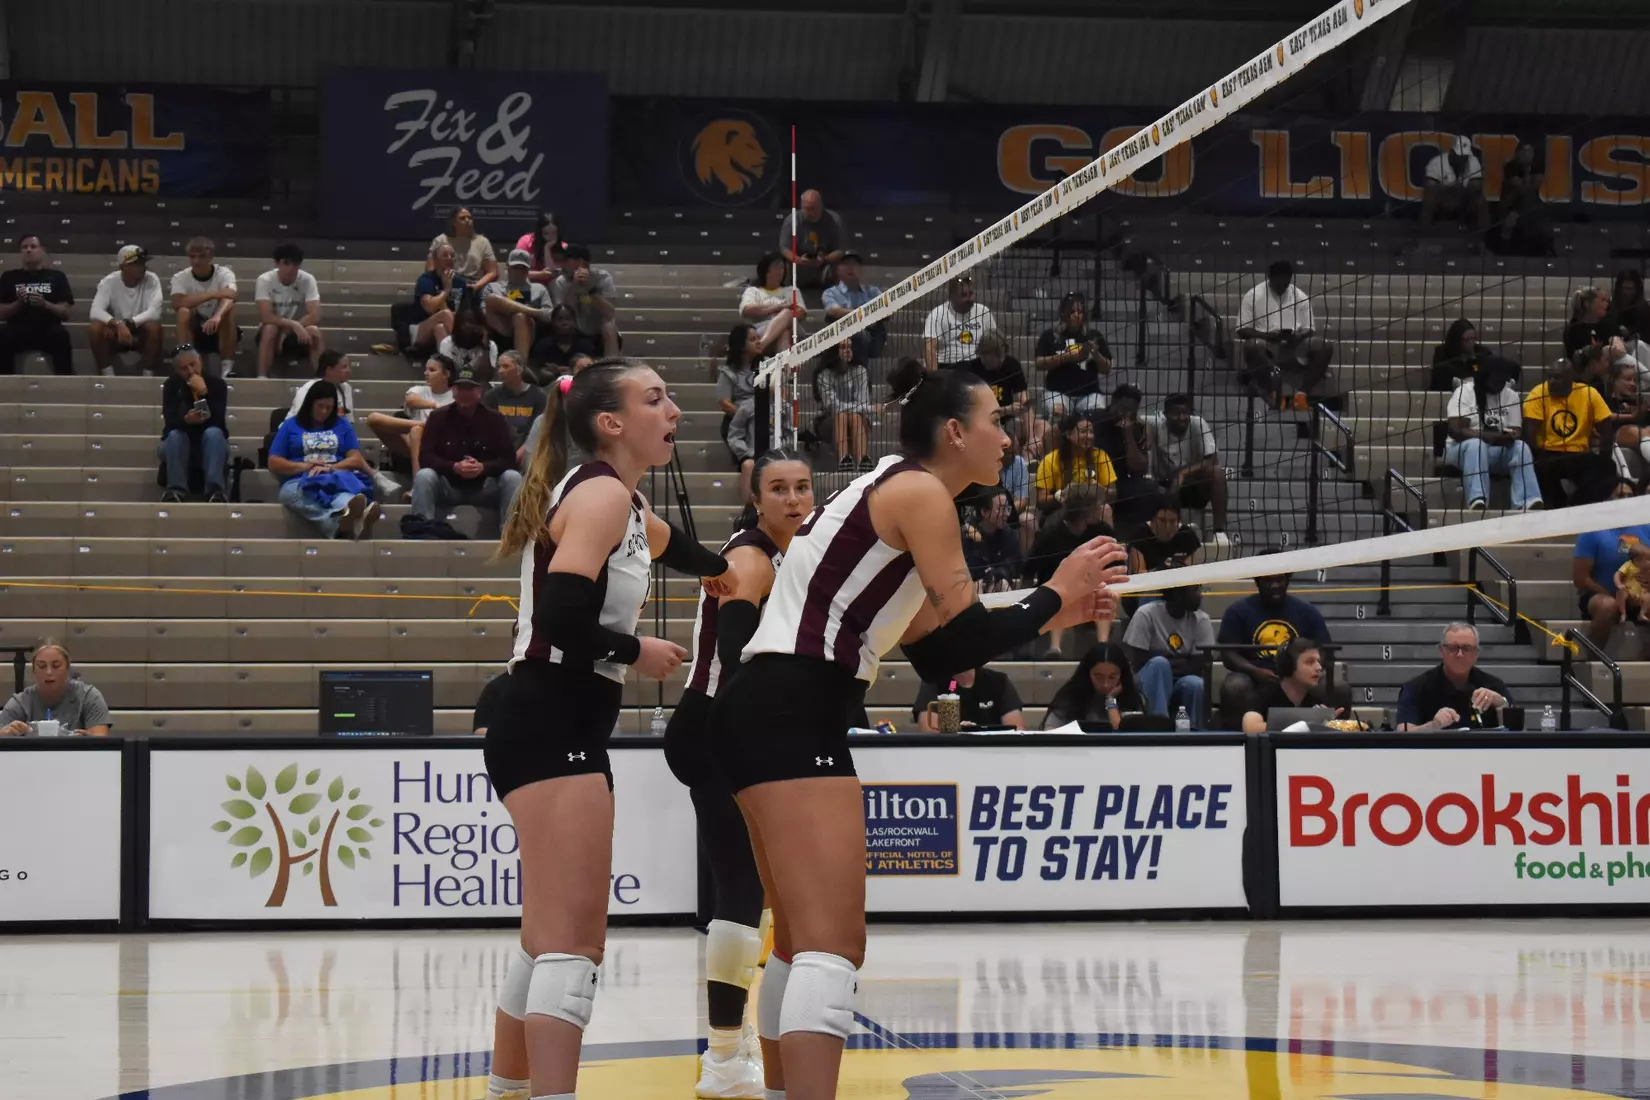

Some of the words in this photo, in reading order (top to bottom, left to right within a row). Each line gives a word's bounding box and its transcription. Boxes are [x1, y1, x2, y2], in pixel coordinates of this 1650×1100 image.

[0, 91, 185, 151] ALL
[384, 88, 477, 154] Fix
[476, 91, 532, 165] &
[0, 156, 161, 194] MERICANS
[408, 146, 544, 210] Feed
[997, 124, 1194, 198] GO
[393, 760, 492, 804] Hun
[862, 790, 948, 819] ilton
[968, 785, 1084, 831] BEST
[1093, 783, 1233, 830] PLACE
[393, 810, 519, 871] Regio
[865, 838, 921, 847] LAKEFRONT
[878, 859, 955, 870] ATHLETICS
[973, 835, 1028, 882] TO
[1040, 834, 1163, 881] STAY!
